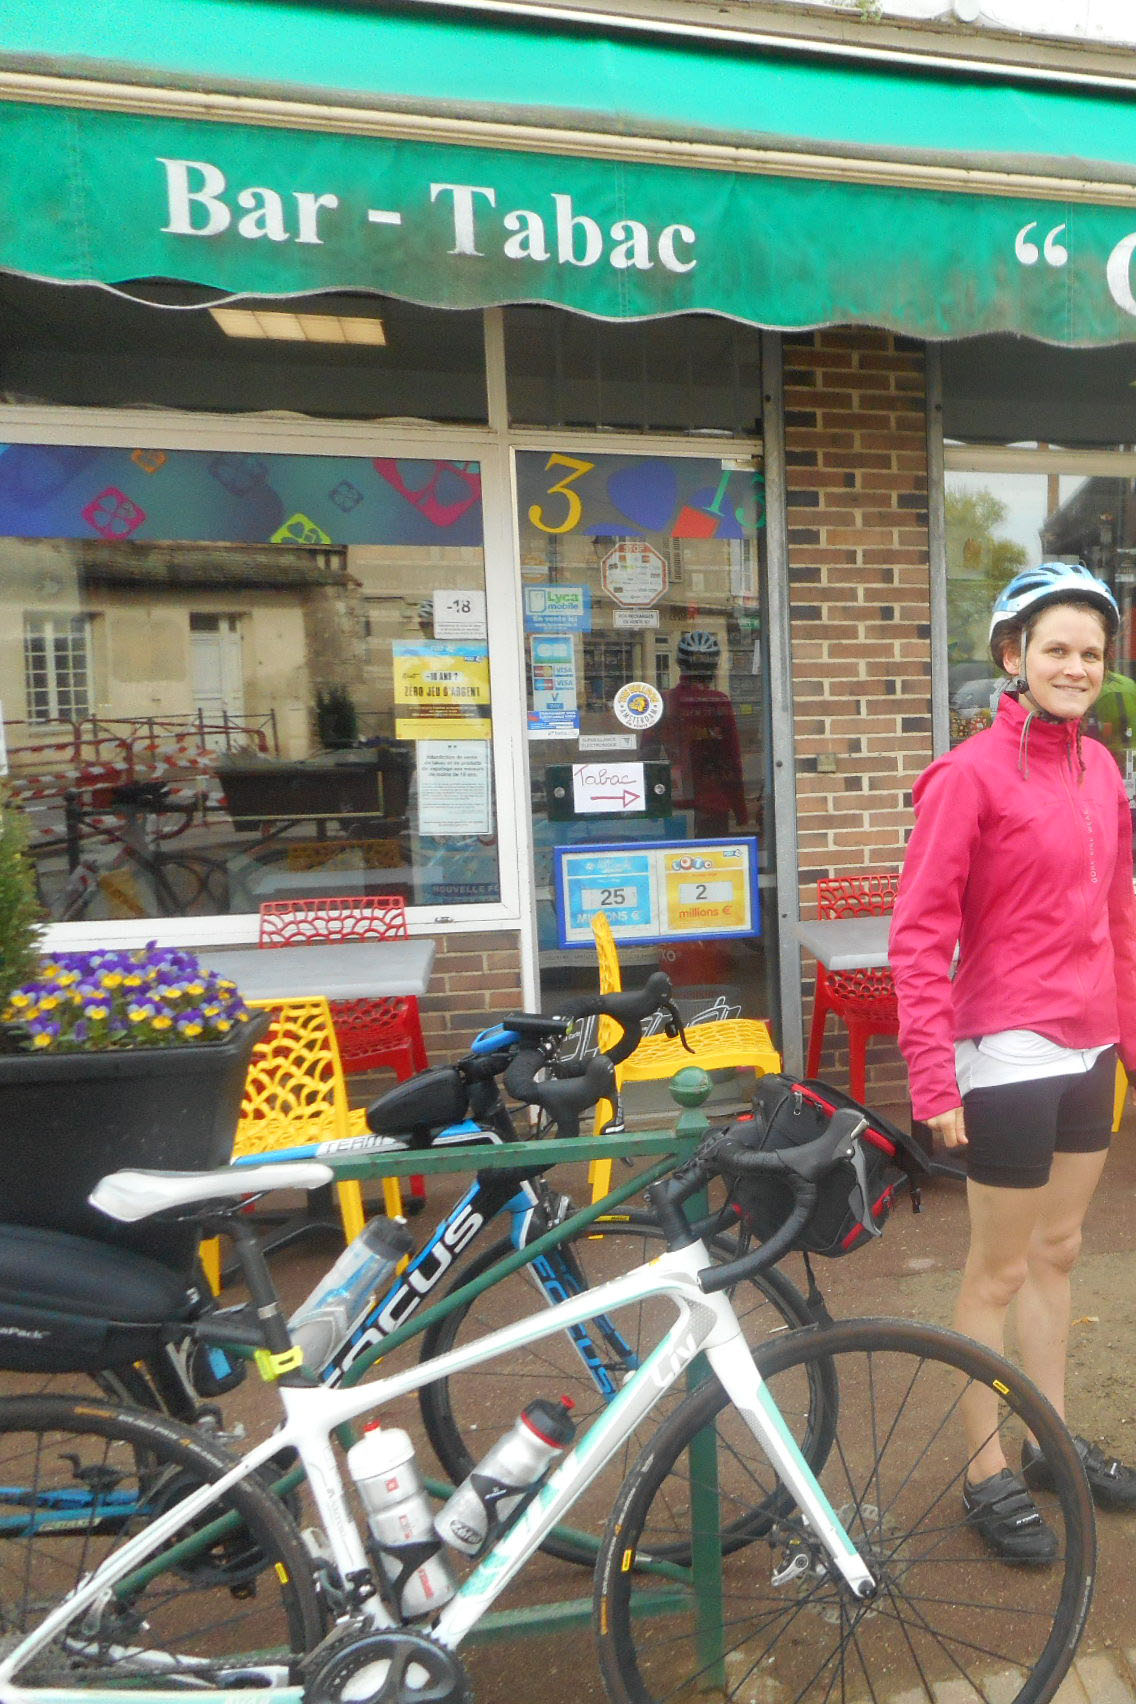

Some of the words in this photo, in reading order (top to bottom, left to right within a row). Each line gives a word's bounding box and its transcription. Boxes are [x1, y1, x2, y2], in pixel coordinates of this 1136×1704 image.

[155, 157, 339, 245] Bar
[429, 181, 698, 273] Tabac
[446, 599, 471, 614] -18
[547, 592, 579, 604] Lyca
[574, 764, 637, 787] Tabac
[600, 888, 626, 906] 25
[695, 884, 708, 900] 2
[679, 907, 719, 920] millions
[326, 1133, 384, 1155] TEAM
[318, 1204, 484, 1388] OCUS
